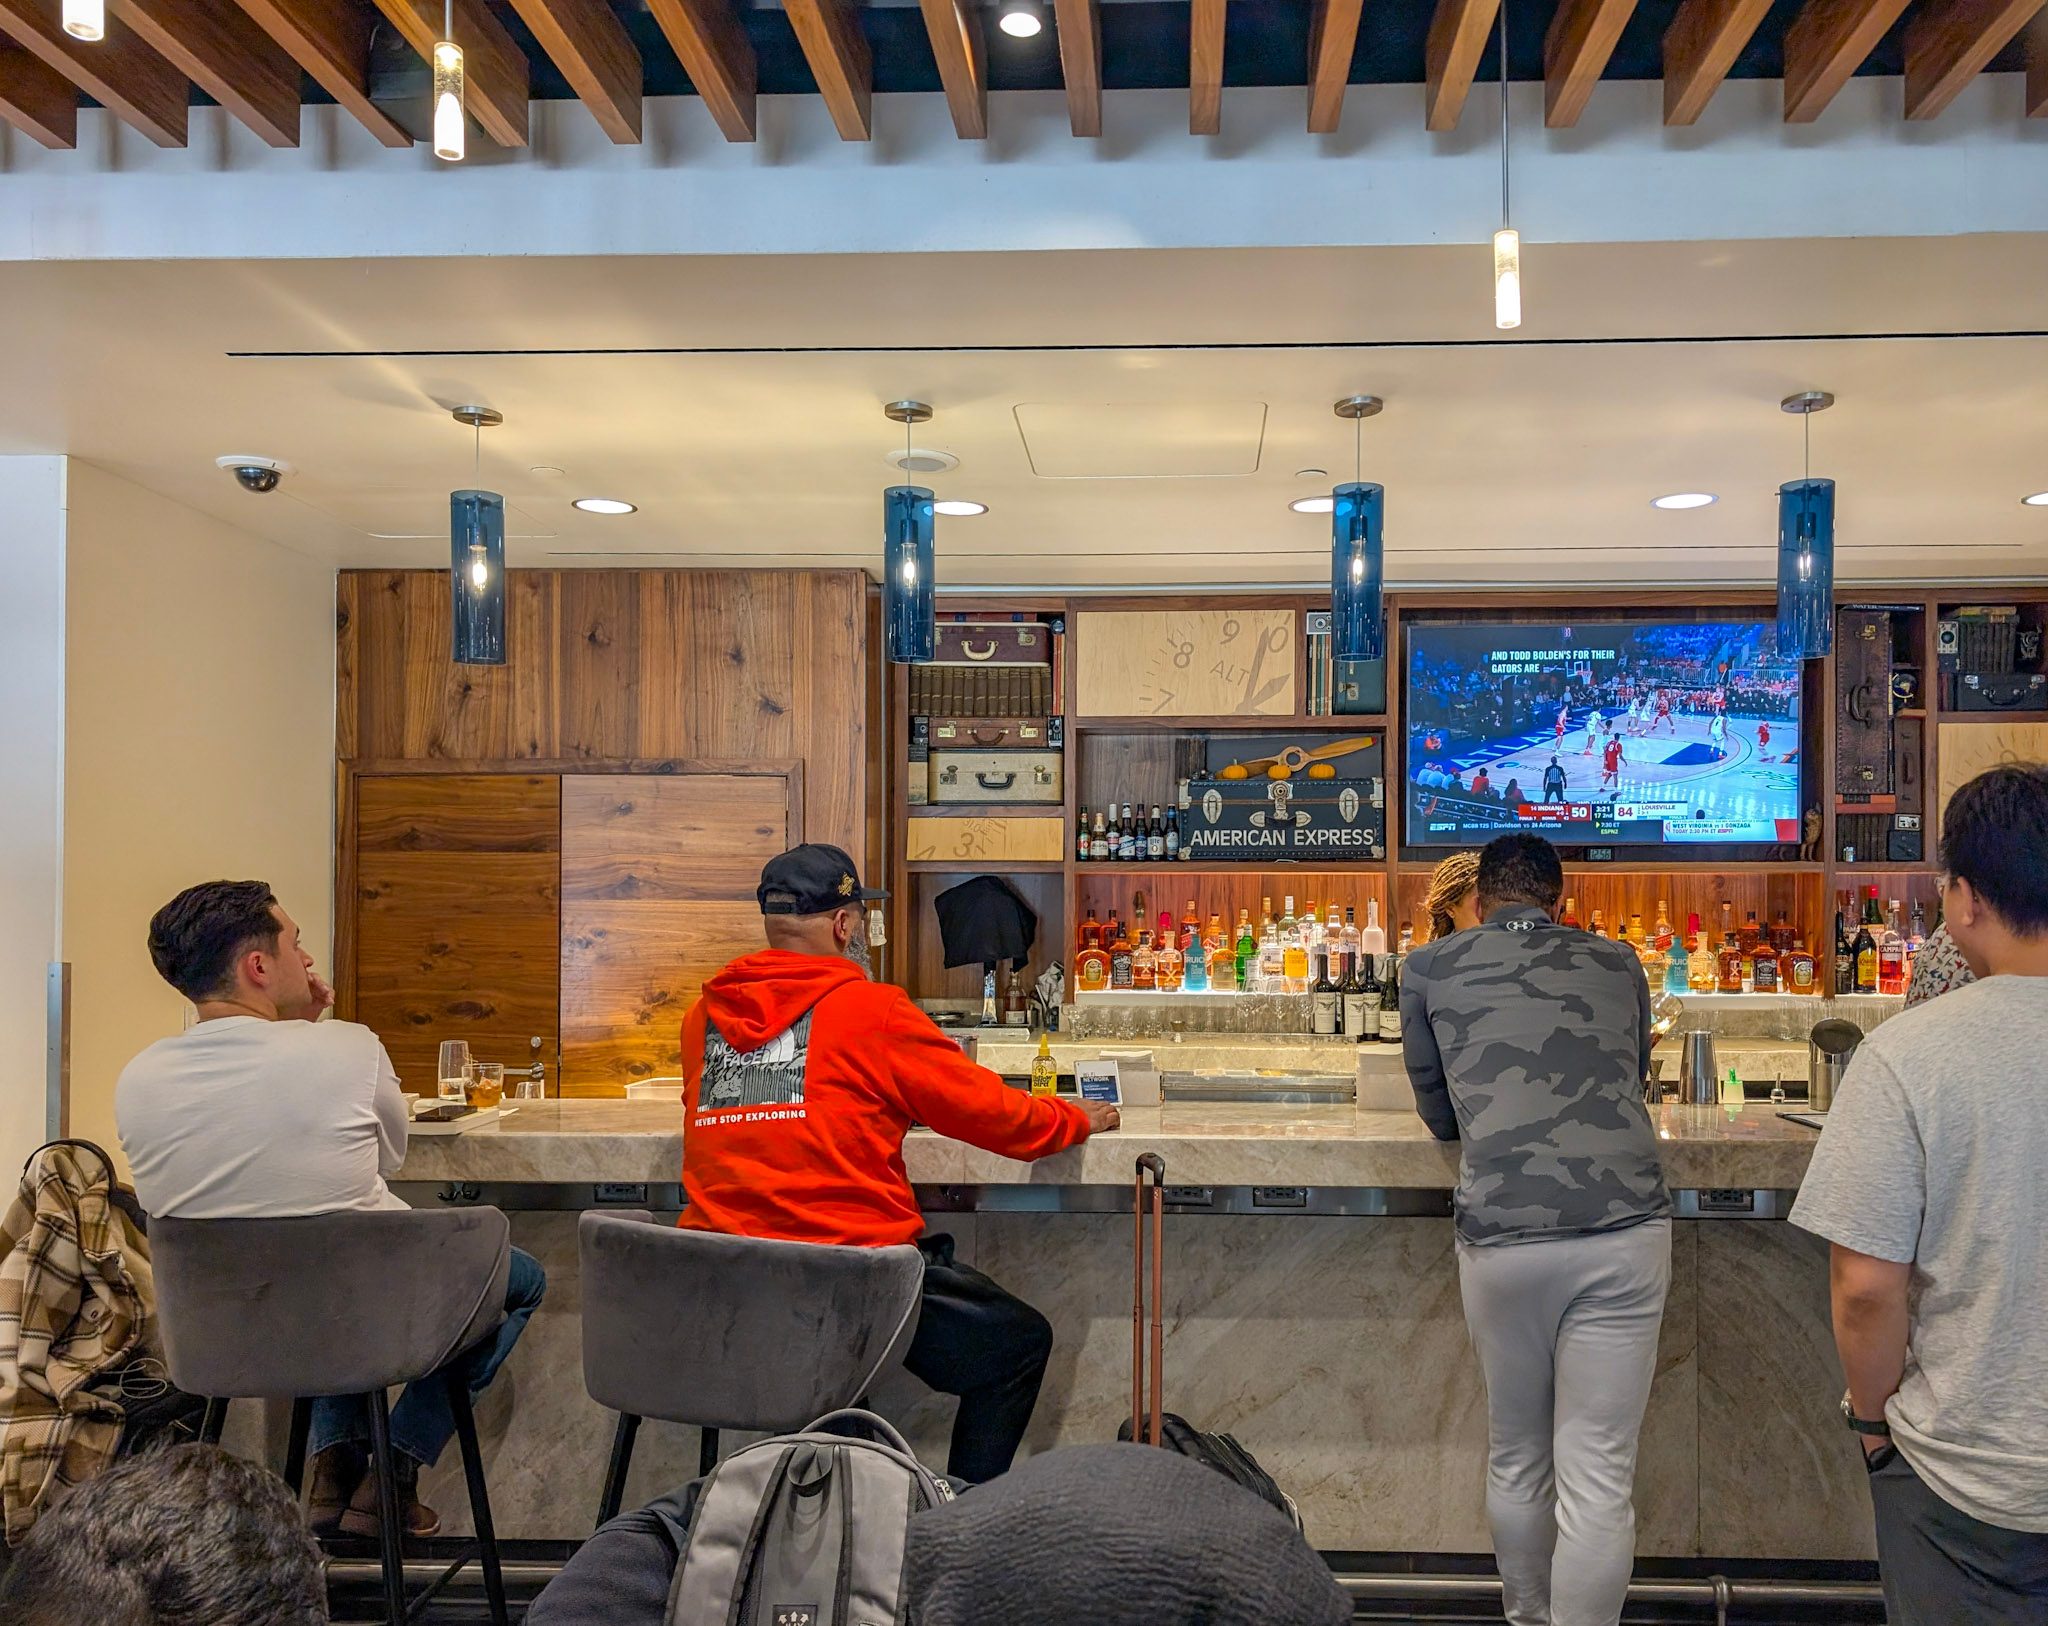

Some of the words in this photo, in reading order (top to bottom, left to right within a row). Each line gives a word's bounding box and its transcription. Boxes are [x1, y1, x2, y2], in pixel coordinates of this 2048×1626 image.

[1220, 619, 1240, 645] 9
[1173, 641, 1194, 669] 8
[1491, 650, 1508, 661] AND
[1510, 650, 1531, 661] TODD
[1533, 650, 1572, 660] BOLDEN'S
[1573, 650, 1589, 660] FOR
[1591, 650, 1615, 660] THEIR
[1209, 660, 1250, 686] ALT
[1491, 663, 1523, 673] GATORS
[1524, 663, 1540, 673] ARE
[1571, 806, 1588, 818] 50
[1617, 806, 1634, 817] 84
[1429, 822, 1457, 831] ESPN
[1493, 821, 1522, 829] Davidson
[953, 832, 975, 858] 3
[1190, 829, 1286, 846] AMERICAN
[1294, 828, 1375, 846] EXPRESS
[723, 1050, 764, 1068] FACE
[695, 1116, 717, 1128] NEVER
[719, 1114, 743, 1124] STOP
[745, 1109, 807, 1122] EXPLORING
